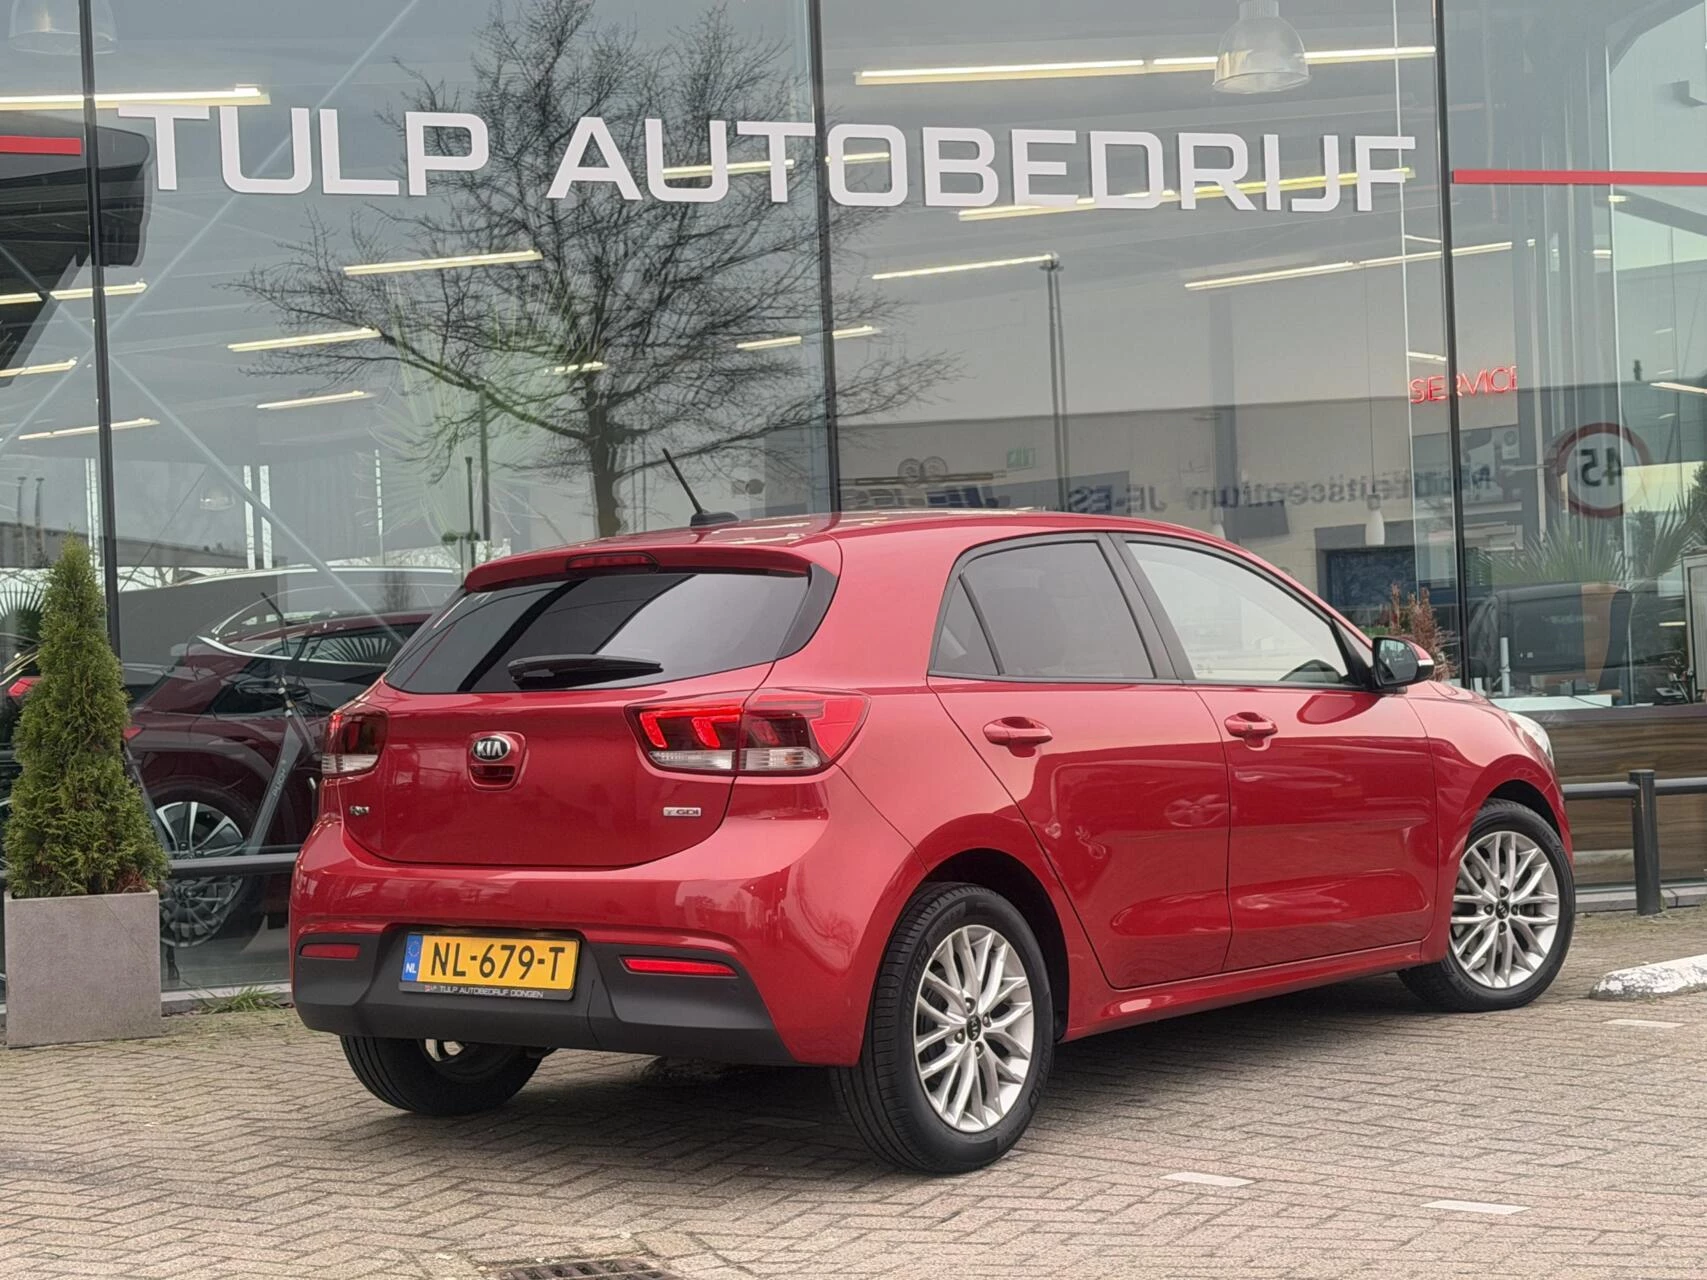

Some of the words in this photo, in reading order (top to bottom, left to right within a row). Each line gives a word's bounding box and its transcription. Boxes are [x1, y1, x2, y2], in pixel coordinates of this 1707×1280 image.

[117, 105, 490, 196] TULP
[545, 116, 1417, 213] AUTOBEDRIJF
[476, 740, 504, 757] KIA
[405, 962, 417, 974] NL
[430, 942, 566, 982] NL-679-T
[440, 985, 459, 994] TULP
[460, 986, 510, 997] AUTOBEDRIJF
[970, 1016, 979, 1040] KIA
